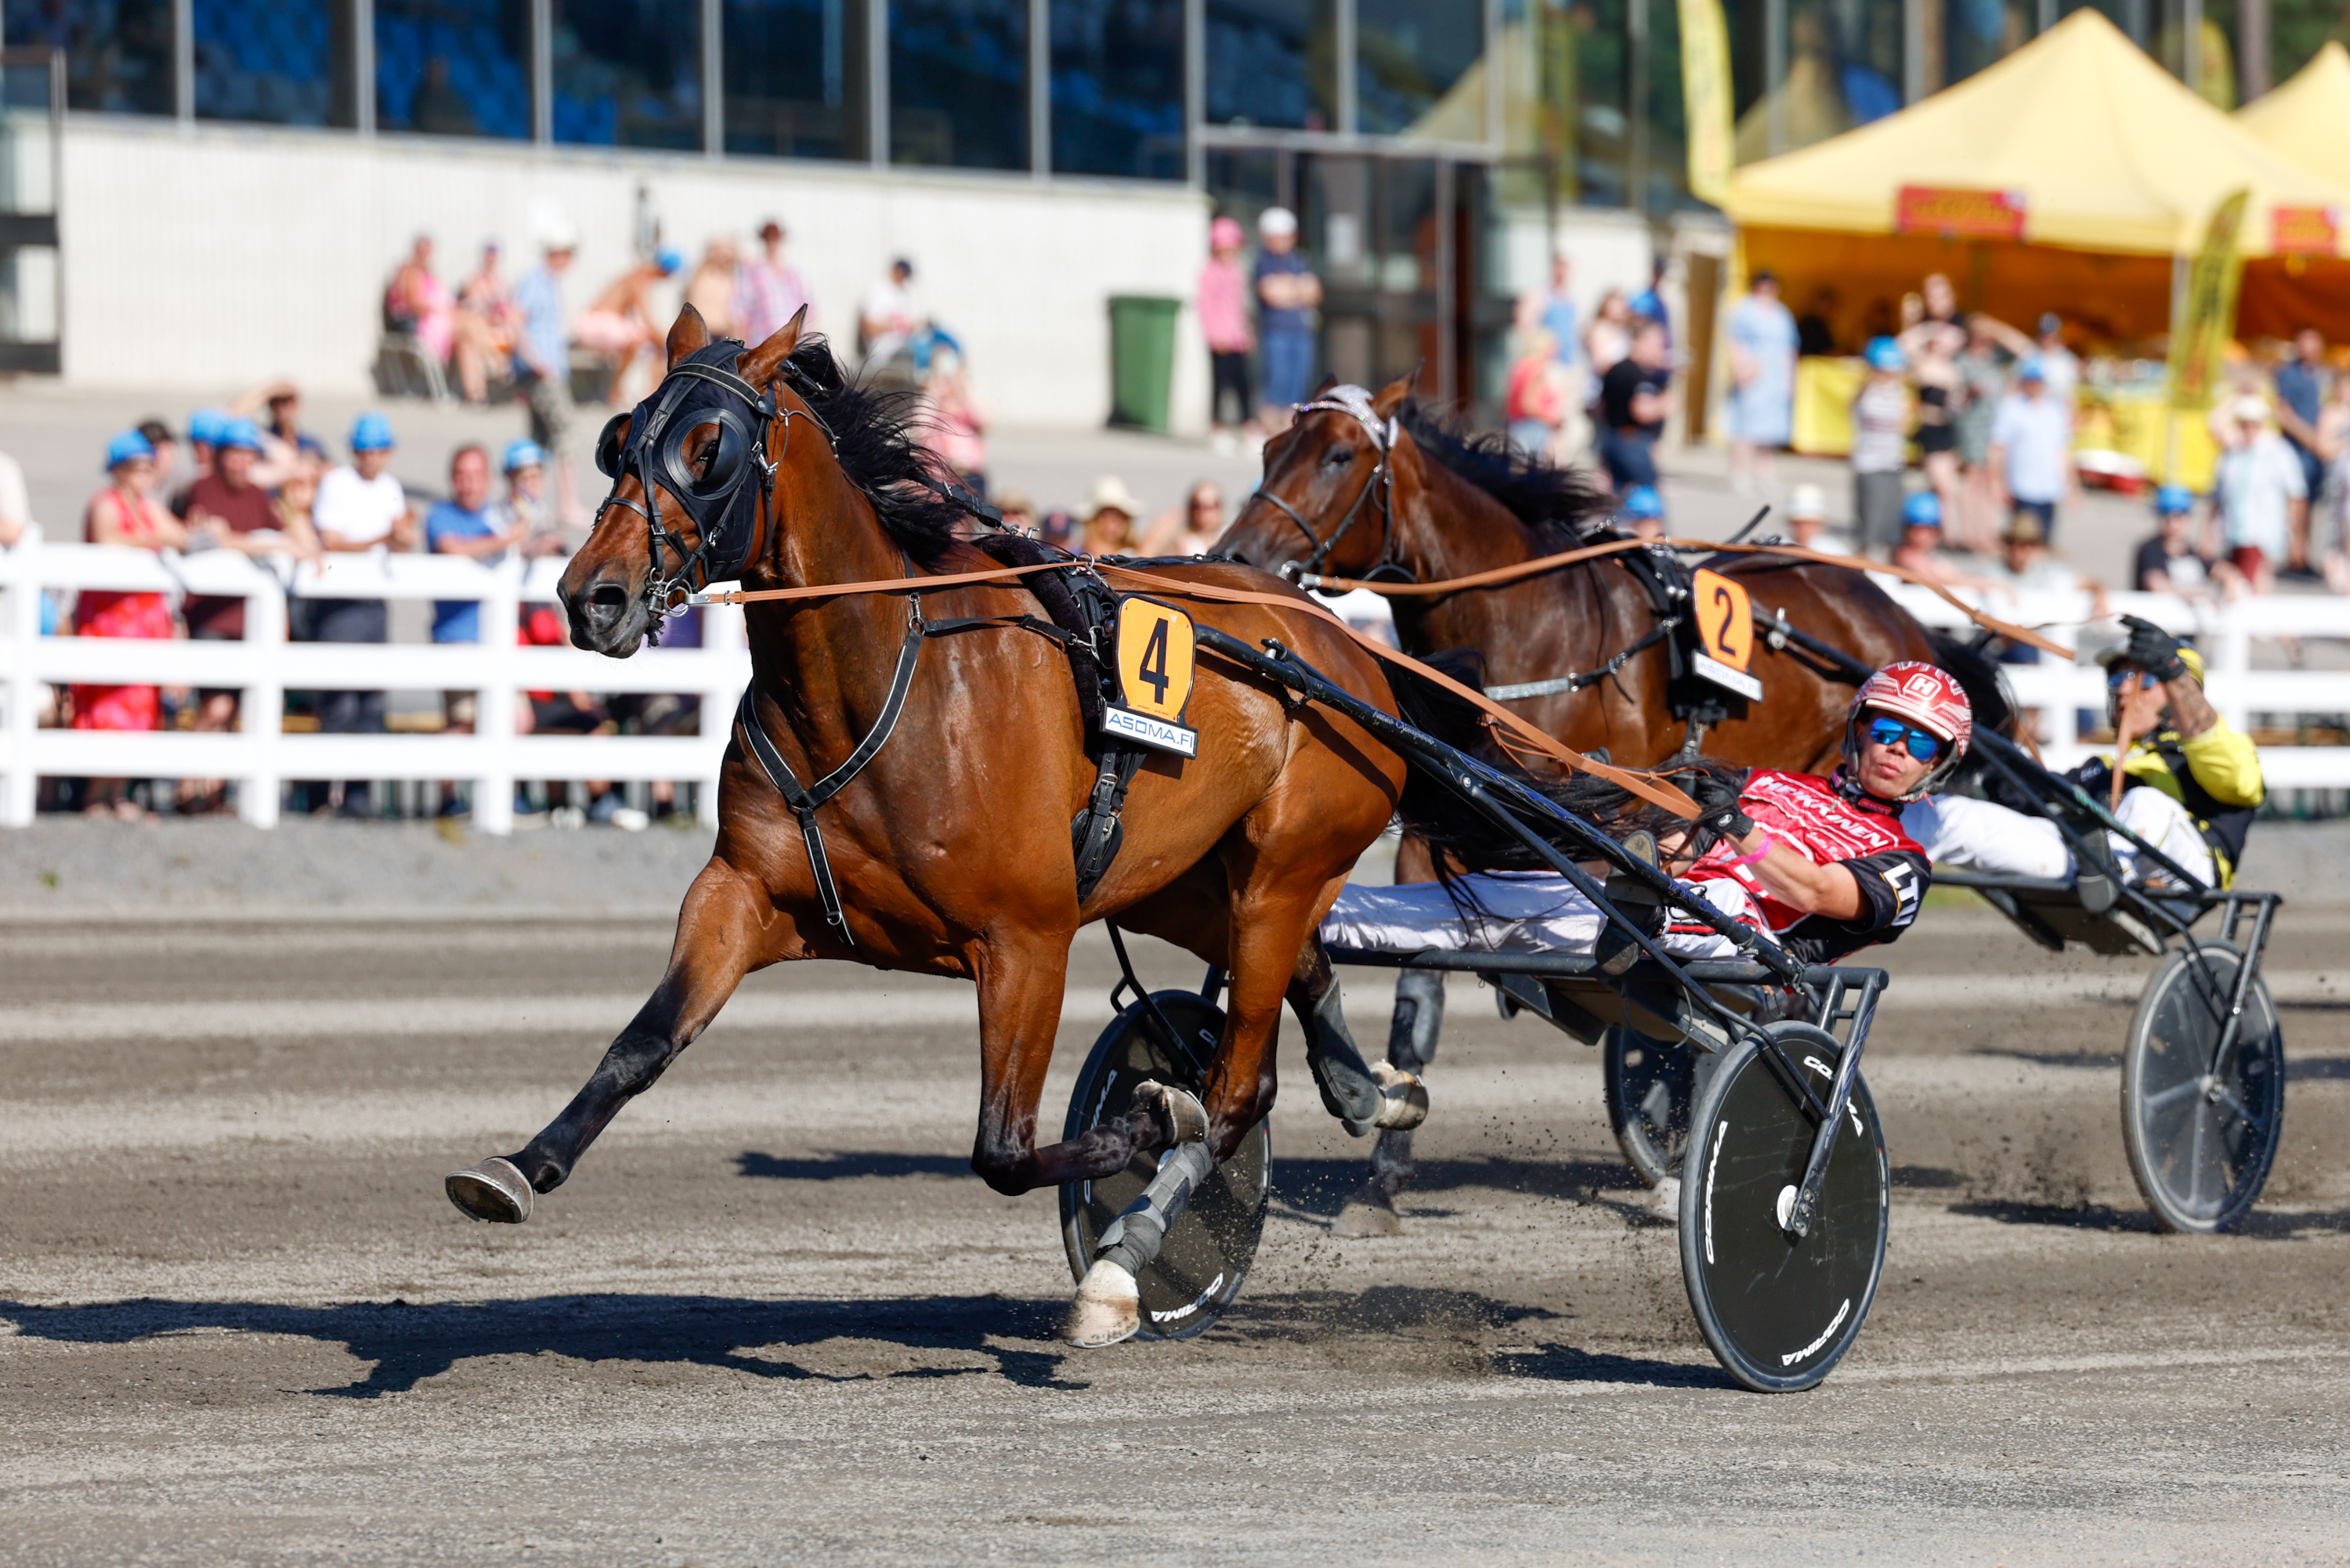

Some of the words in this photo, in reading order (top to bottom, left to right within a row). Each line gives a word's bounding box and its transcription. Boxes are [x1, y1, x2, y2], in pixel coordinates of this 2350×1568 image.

[1713, 584, 1737, 657] 2
[1139, 617, 1170, 705] 4
[1911, 676, 1936, 698] H
[1108, 713, 1194, 749] ASOMA.FI
[1705, 1120, 1730, 1266] CORIMA
[1150, 1271, 1224, 1323] CORIMA
[1781, 1298, 1850, 1367] CORIMA
